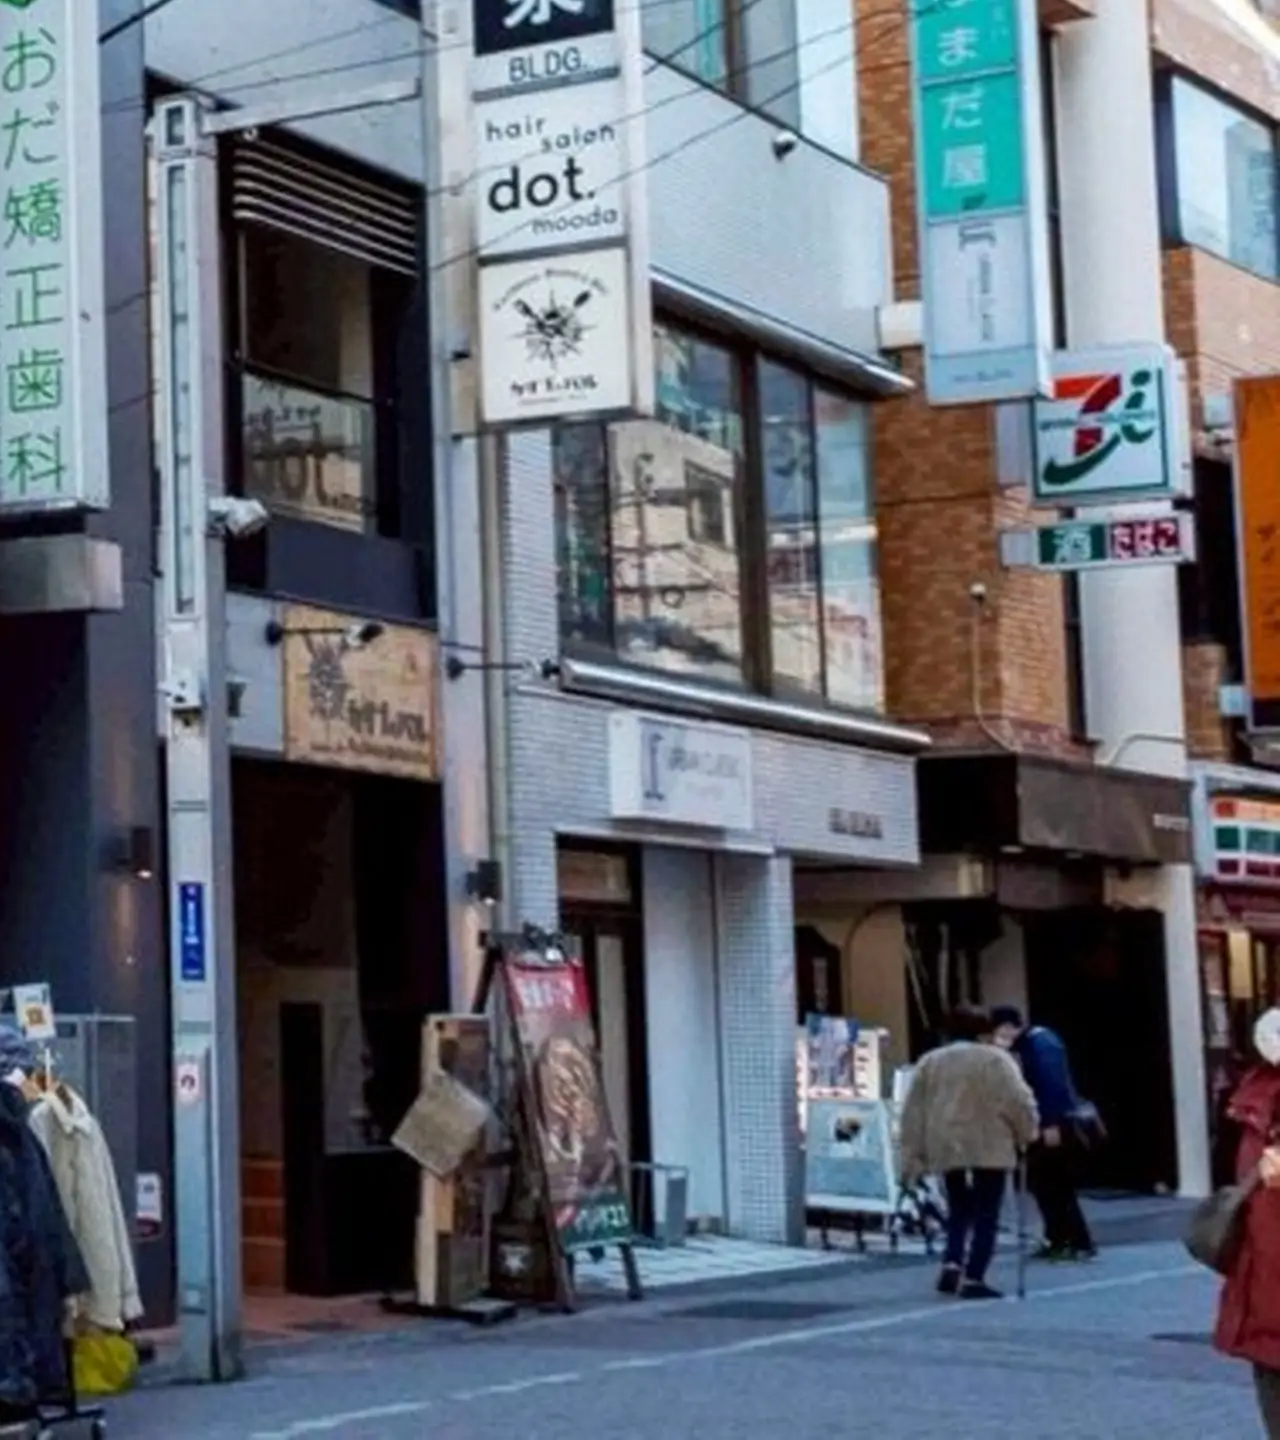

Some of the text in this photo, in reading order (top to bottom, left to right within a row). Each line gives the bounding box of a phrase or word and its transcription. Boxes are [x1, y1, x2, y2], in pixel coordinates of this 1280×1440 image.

[485, 115, 616, 154] hair salon
[488, 156, 596, 213] dot.
[0, 27, 67, 494] おだ矯正歯科
[1112, 519, 1177, 561] たばこ
